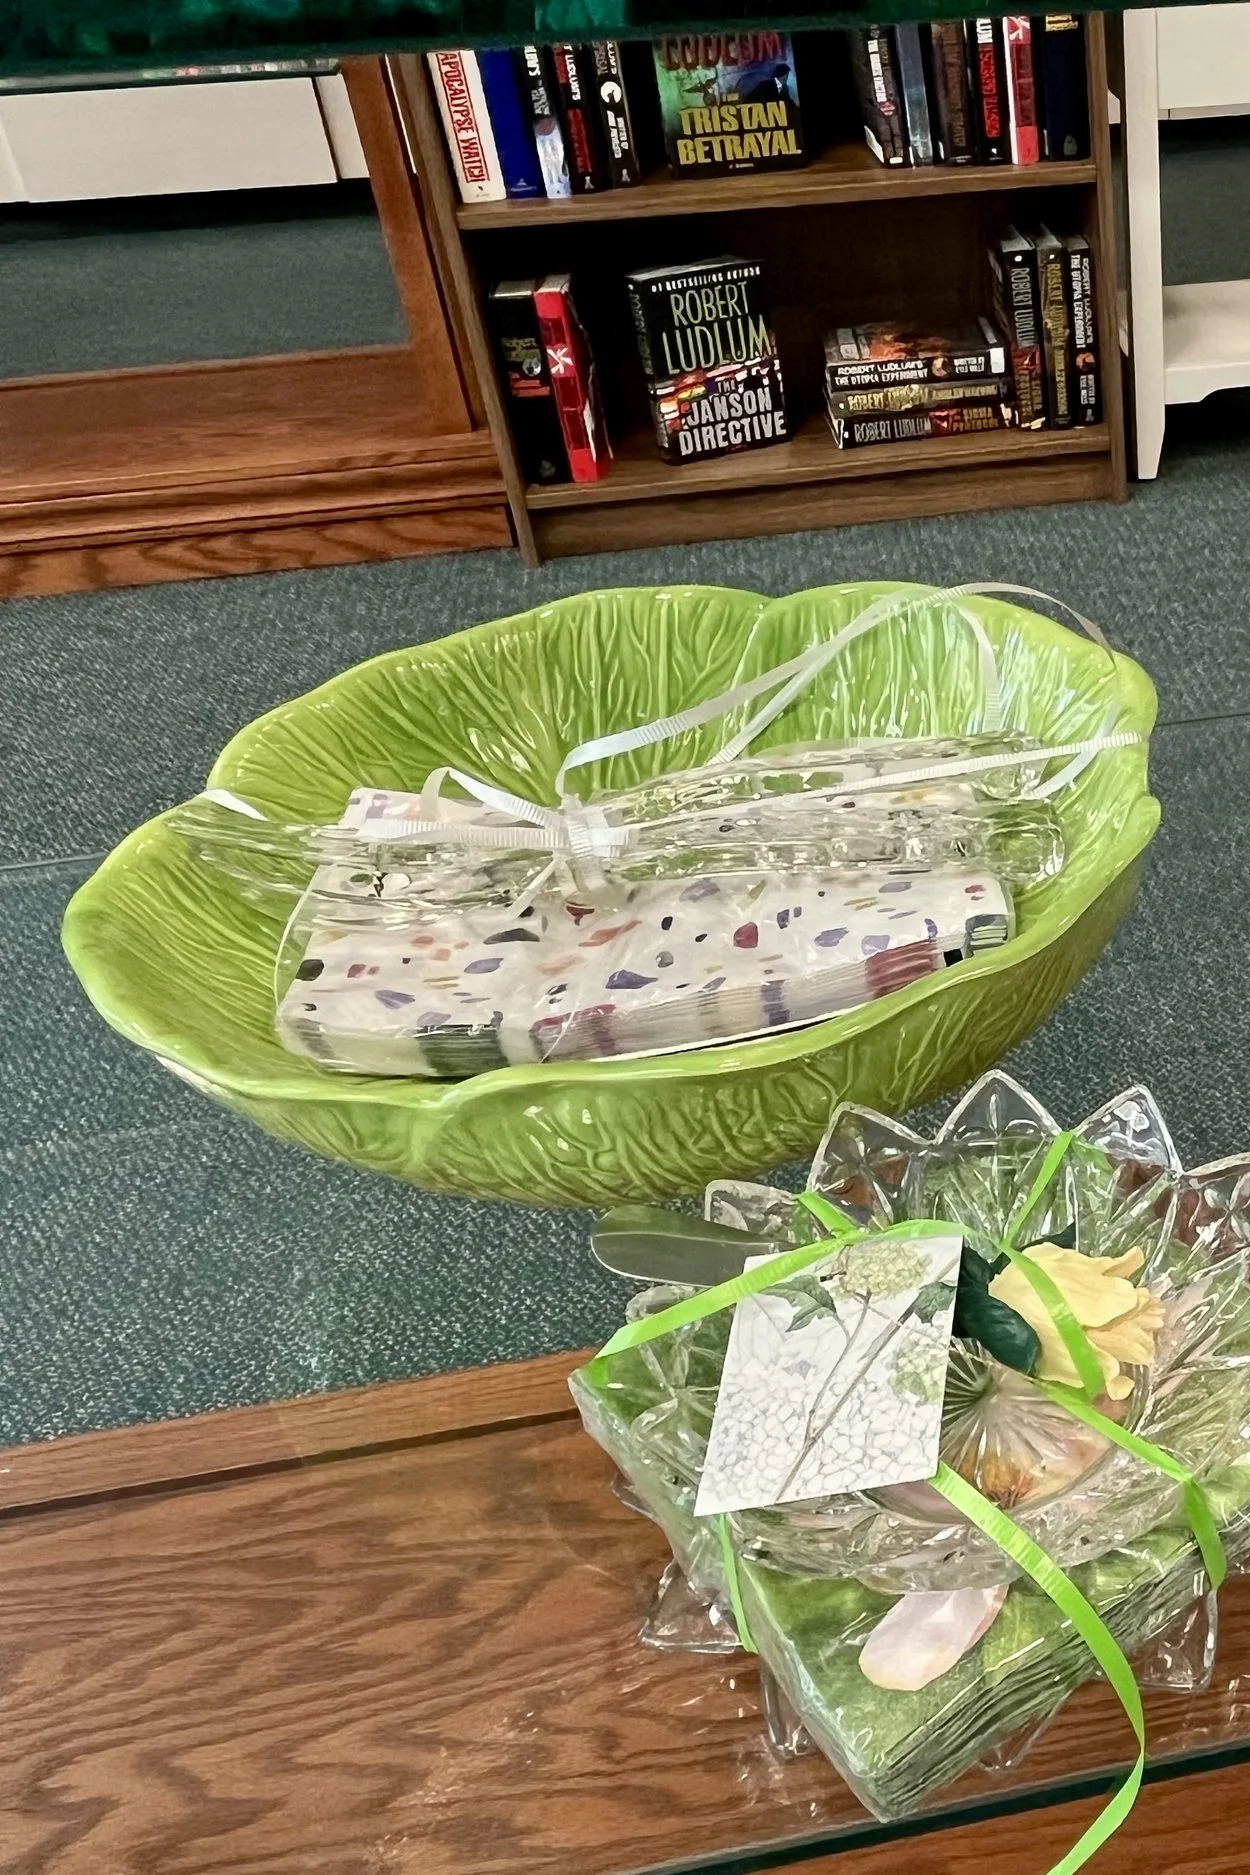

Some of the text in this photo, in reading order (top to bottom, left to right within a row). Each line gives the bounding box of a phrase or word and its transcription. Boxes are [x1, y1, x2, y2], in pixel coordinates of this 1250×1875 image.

[438, 53, 476, 134] APOCALYPSE
[460, 133, 487, 183] WATCH
[679, 101, 788, 135] TRISTAN
[677, 129, 802, 165] BETRAYAL
[670, 281, 748, 326] ROBERT
[1011, 267, 1032, 306] ROBERT
[663, 314, 772, 375] LUDLUM
[686, 387, 772, 426] JANSON
[679, 411, 787, 456] DIRECTIVE
[854, 421, 892, 443] ROBERT
